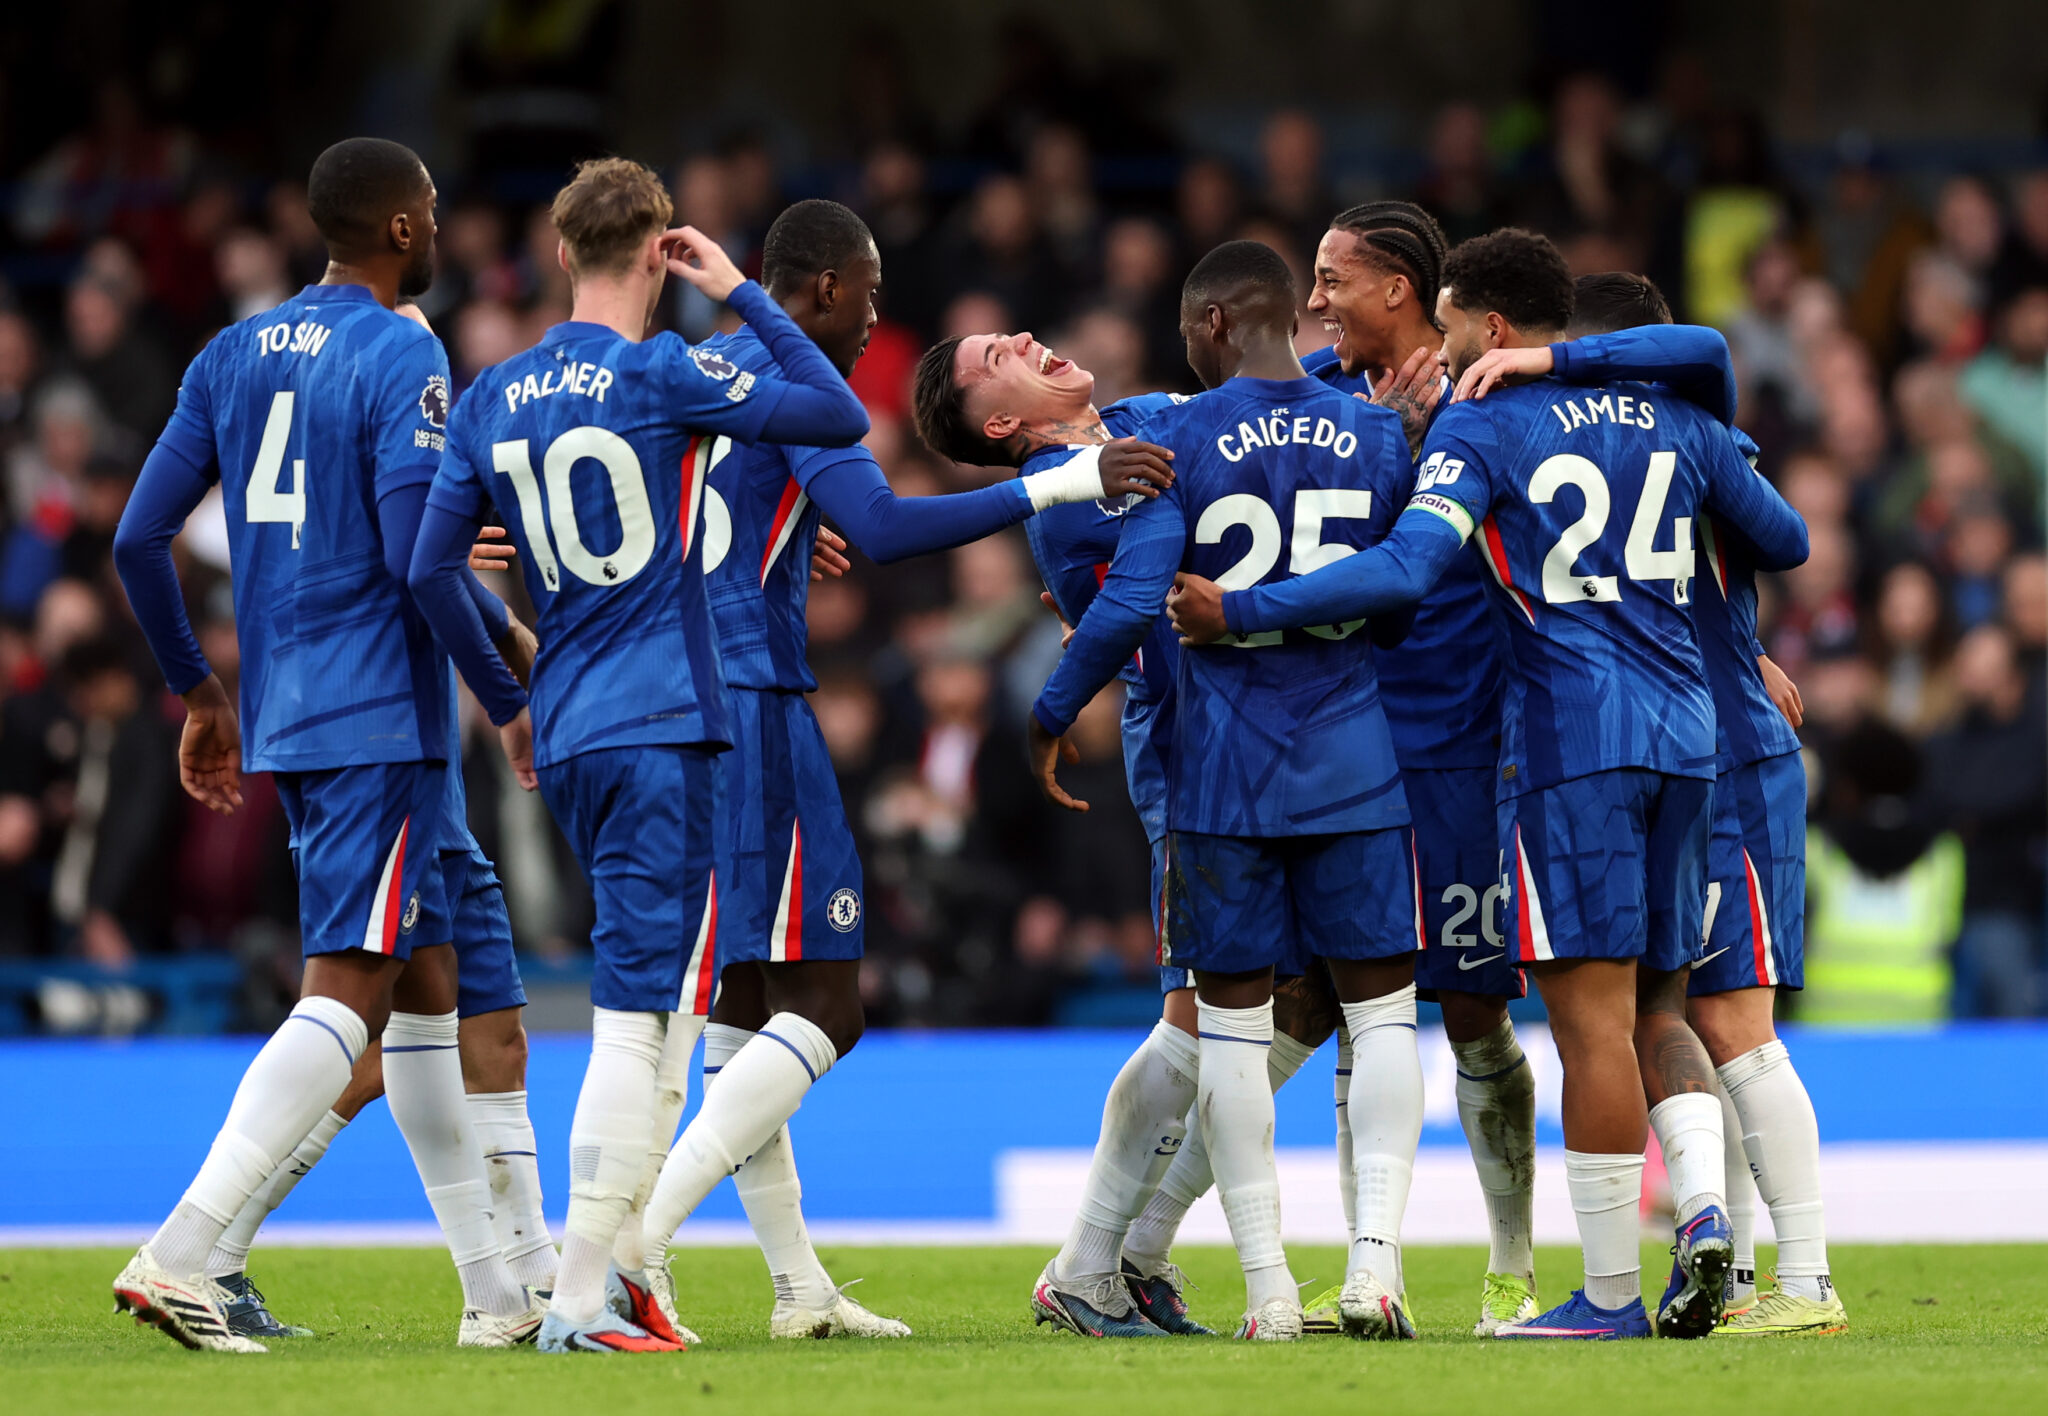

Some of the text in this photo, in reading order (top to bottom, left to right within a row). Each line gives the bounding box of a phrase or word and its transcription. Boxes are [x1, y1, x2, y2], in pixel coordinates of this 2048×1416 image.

[257, 322, 332, 357] TOSIN
[504, 361, 614, 414] PALMER
[1551, 394, 1656, 434] JAMES
[1217, 416, 1358, 462] CAICEDO
[246, 391, 306, 550] 4
[492, 425, 656, 592] 10
[1528, 451, 1696, 605] 24
[1195, 489, 1372, 648] 25
[1161, 1135, 1183, 1146] CF
